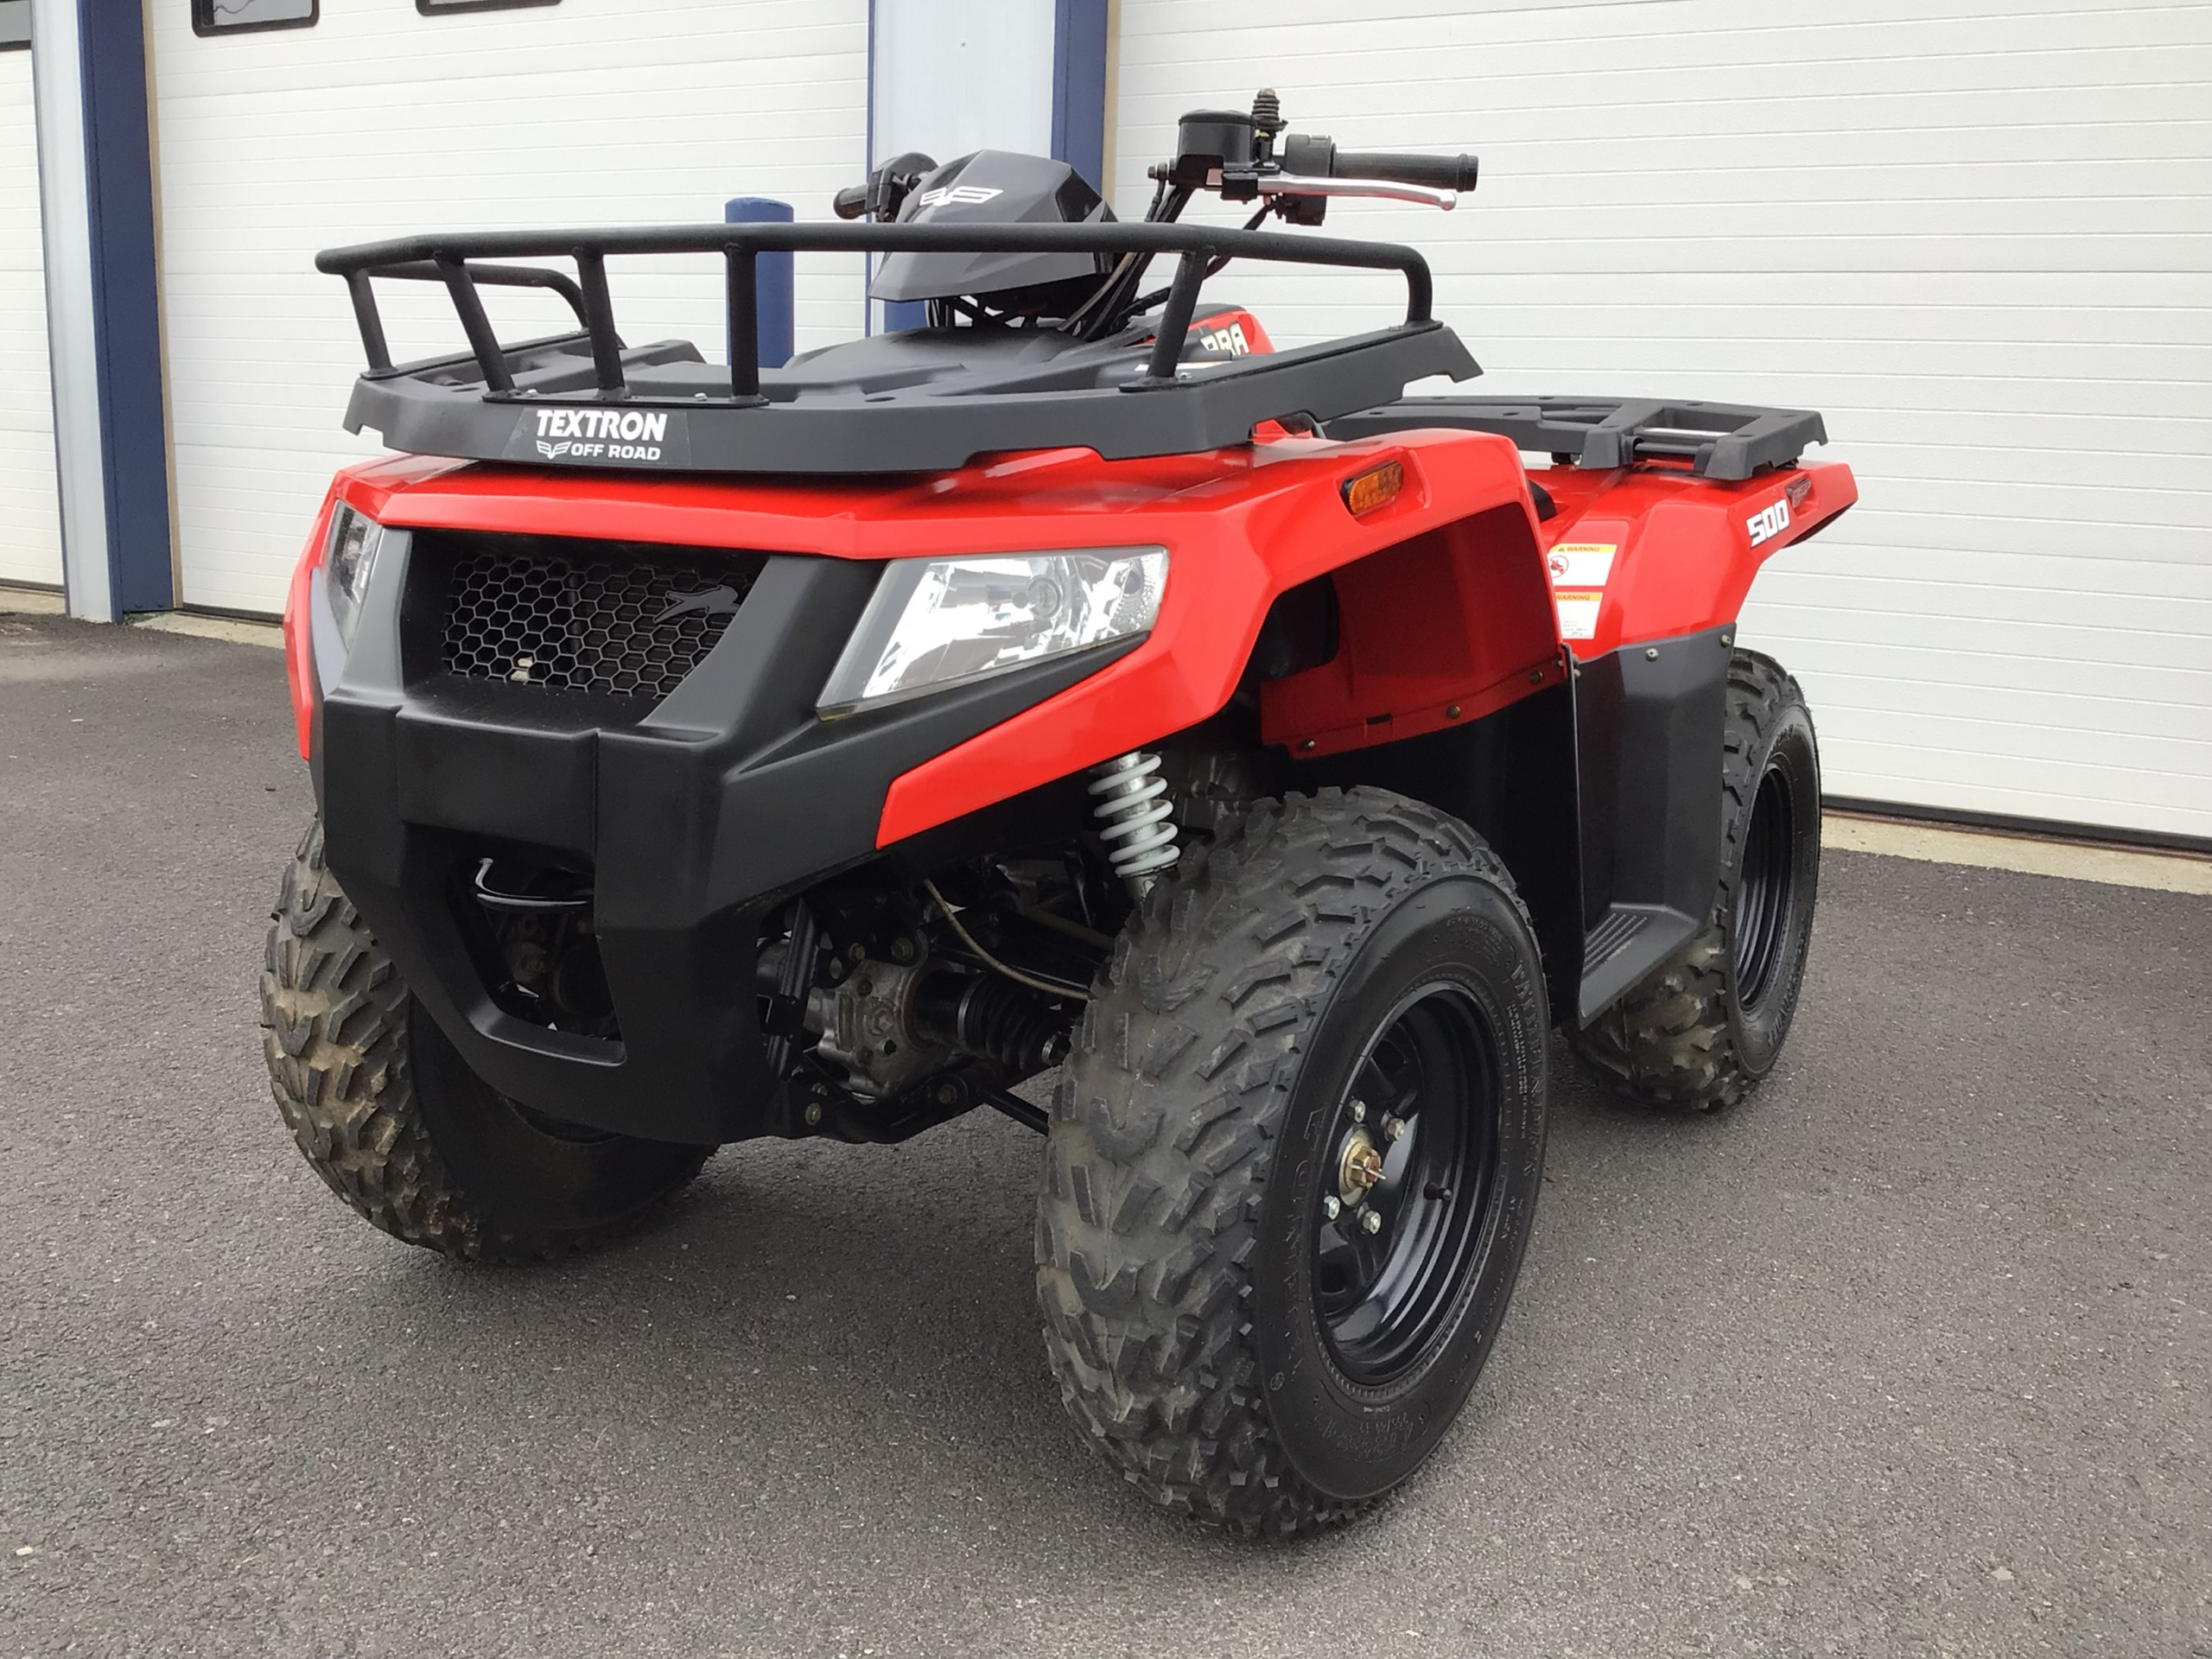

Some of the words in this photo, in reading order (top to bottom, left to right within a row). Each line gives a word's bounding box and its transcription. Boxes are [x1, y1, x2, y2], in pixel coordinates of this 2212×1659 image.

[537, 410, 668, 442] TEXTRON
[570, 442, 605, 457] OFF
[607, 445, 662, 461] ROAD
[1746, 499, 1790, 548] 500
